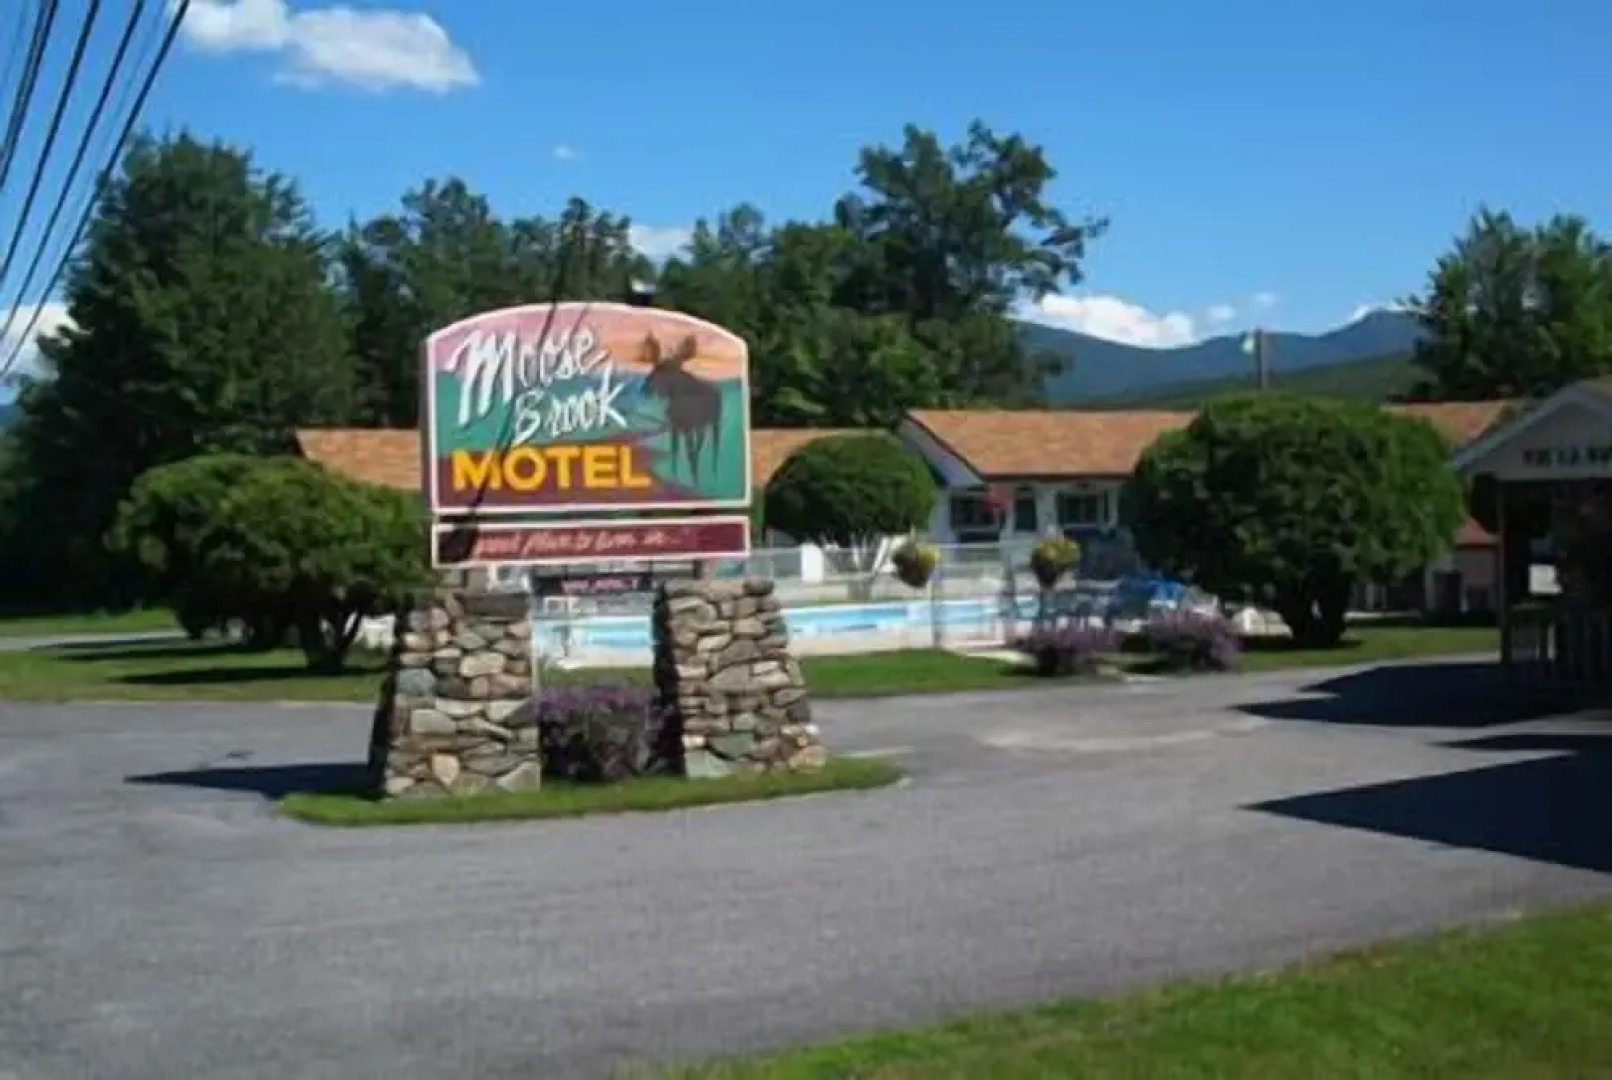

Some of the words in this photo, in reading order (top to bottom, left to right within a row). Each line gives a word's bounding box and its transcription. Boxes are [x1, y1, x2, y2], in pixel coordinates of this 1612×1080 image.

[446, 326, 608, 425] Moose
[511, 364, 628, 446] Brook
[452, 445, 652, 491] MOTEL
